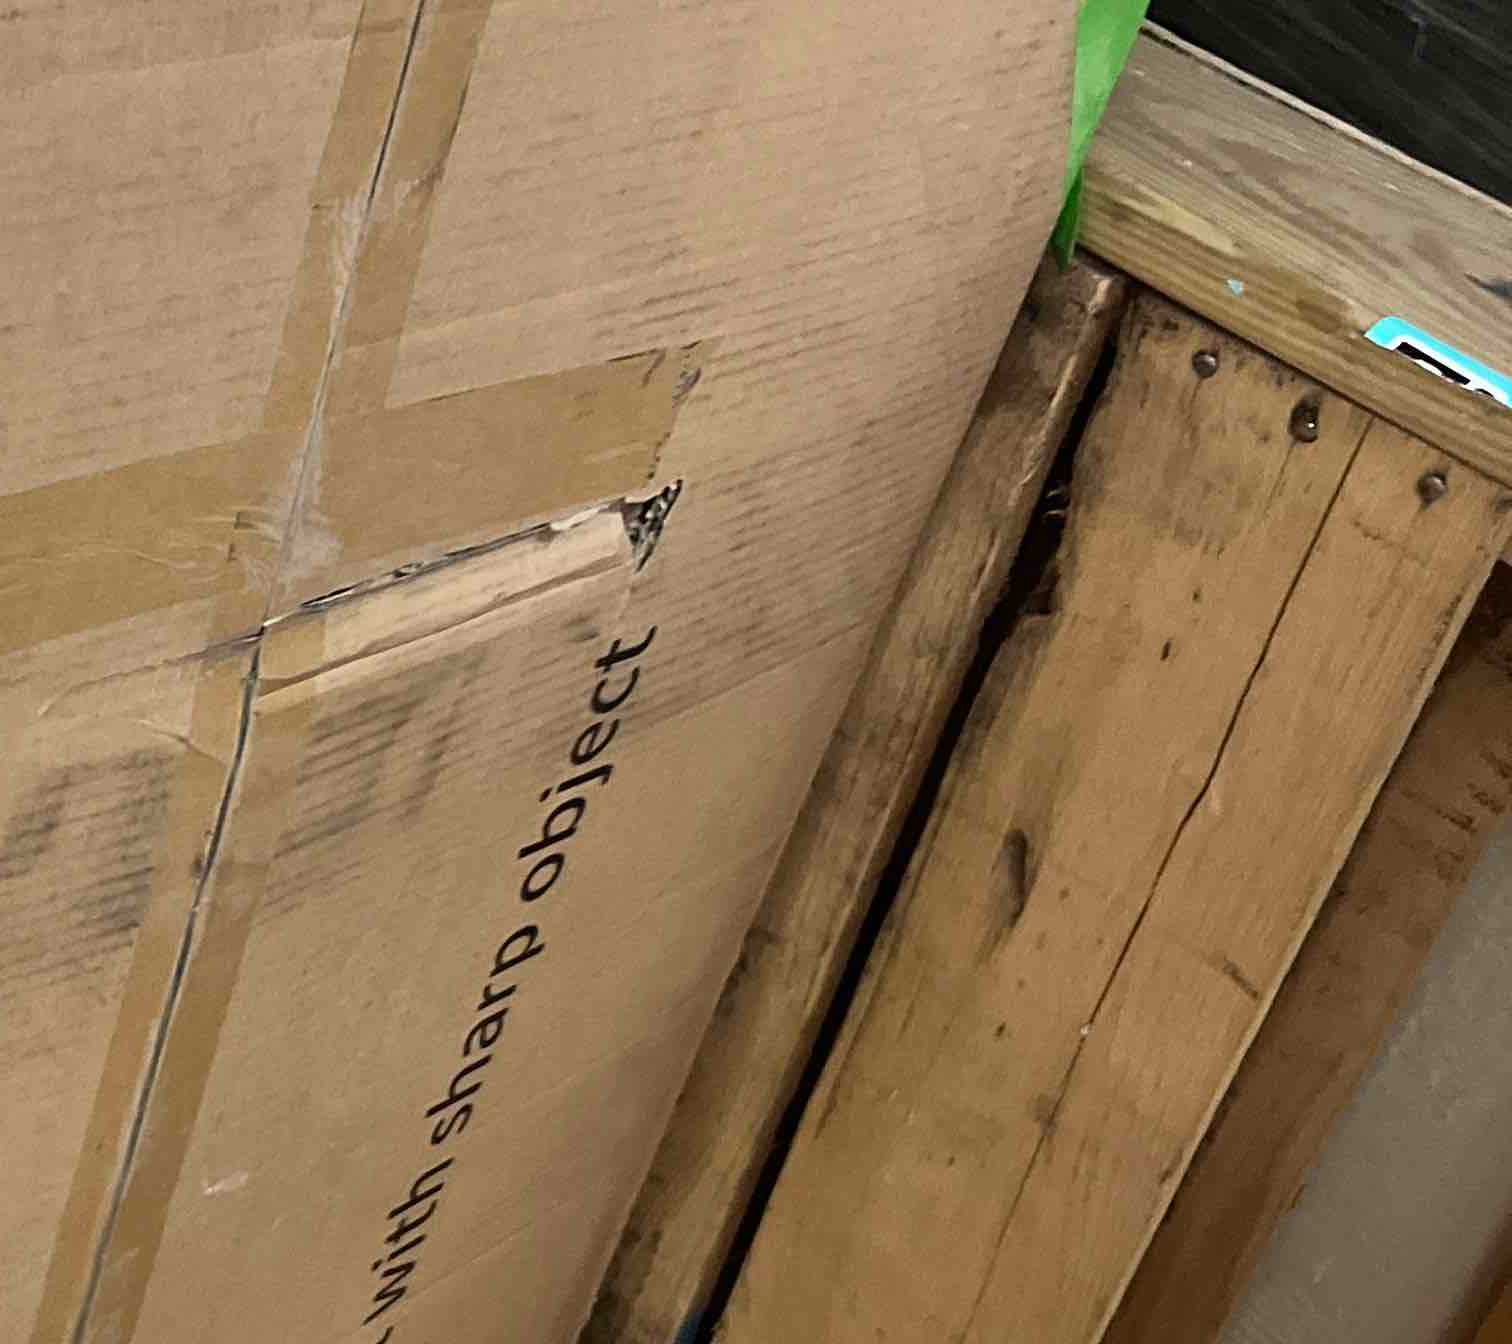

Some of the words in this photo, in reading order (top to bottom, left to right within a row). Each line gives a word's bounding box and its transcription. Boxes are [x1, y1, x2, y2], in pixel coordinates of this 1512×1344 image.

[362, 1156, 456, 1327] with
[424, 922, 545, 1148] sharp
[516, 624, 658, 903] object
